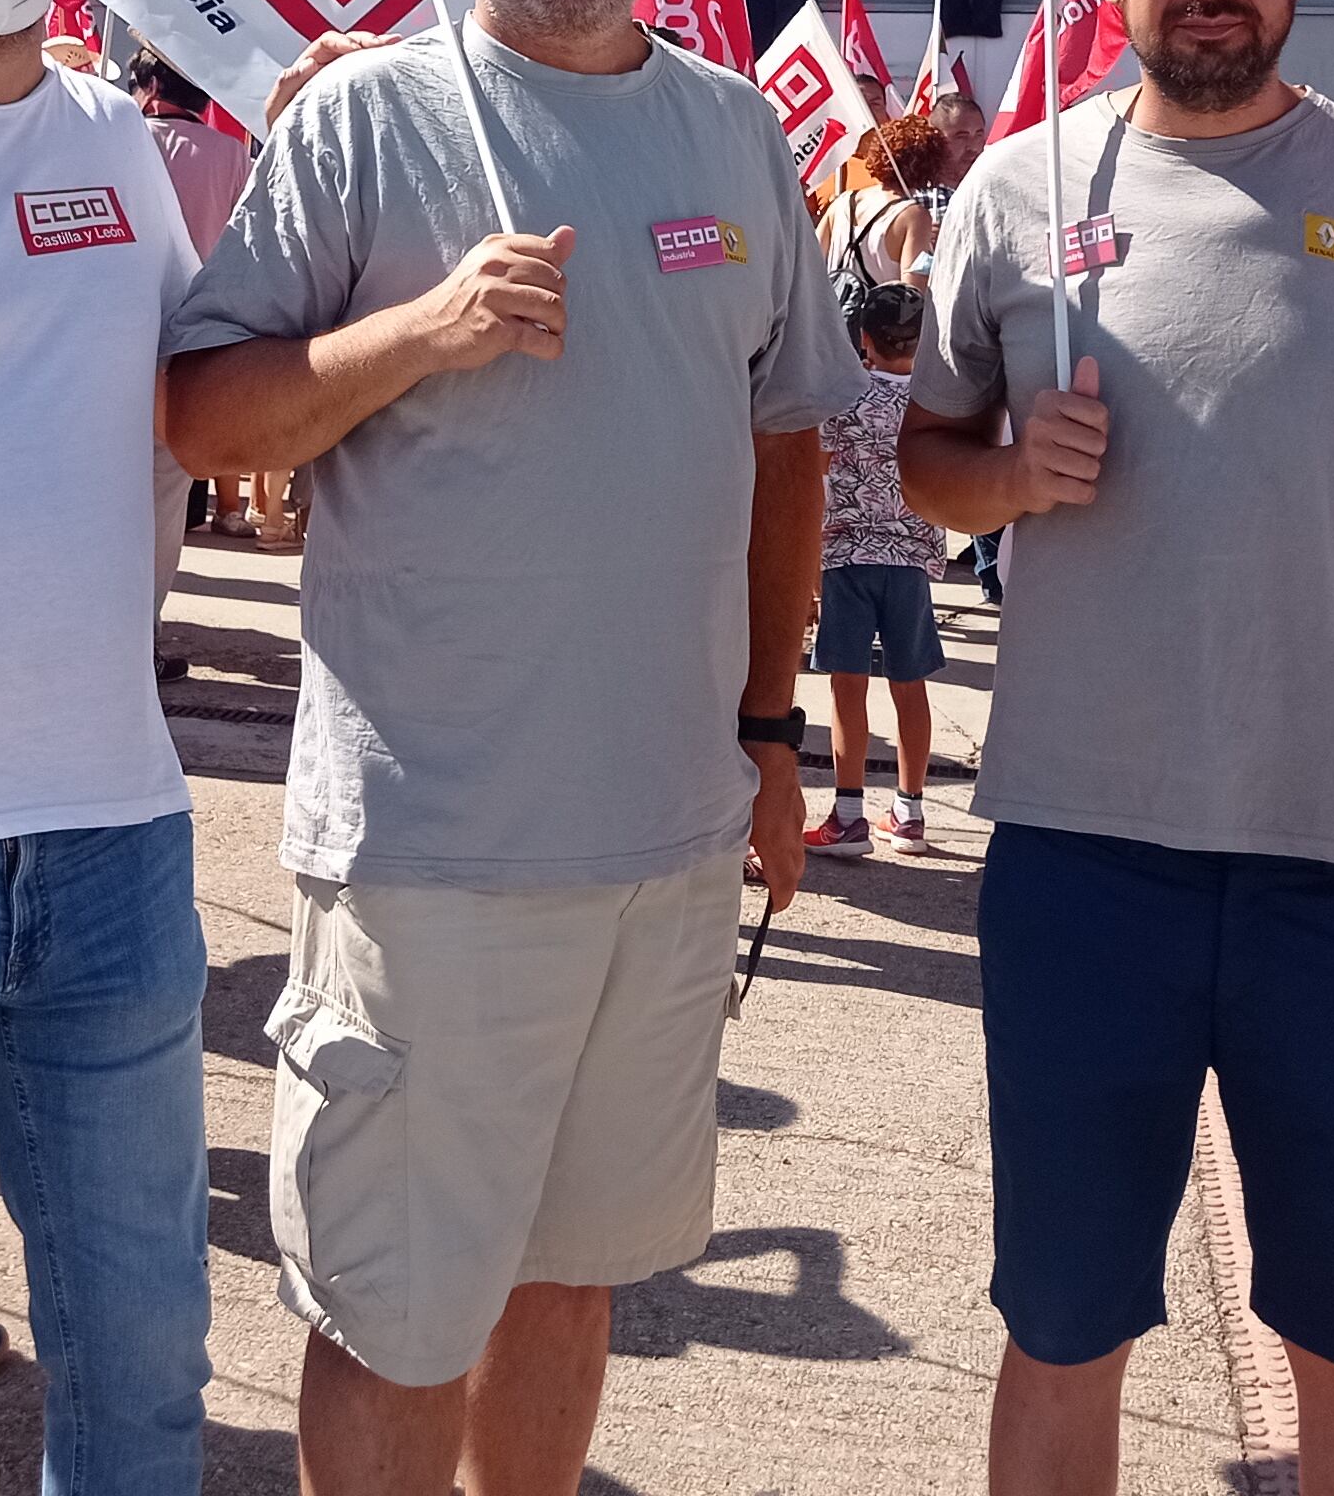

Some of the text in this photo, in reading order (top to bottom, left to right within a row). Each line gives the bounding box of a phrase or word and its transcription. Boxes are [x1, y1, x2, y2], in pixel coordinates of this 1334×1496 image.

[30, 198, 110, 225] CCOO
[32, 225, 126, 248] Castilla y León
[657, 225, 721, 251] CCOO
[1064, 223, 1115, 251] COO
